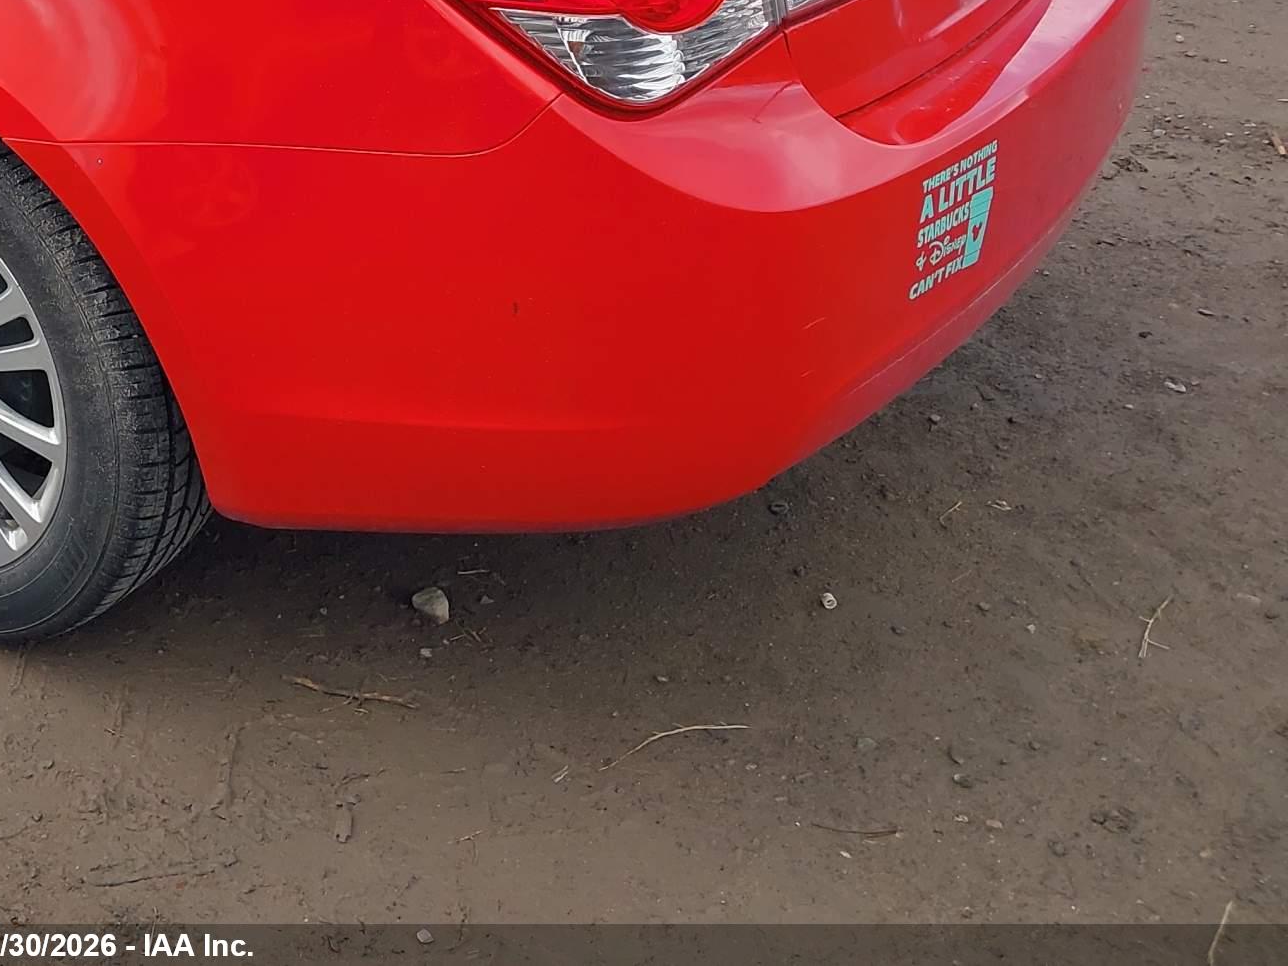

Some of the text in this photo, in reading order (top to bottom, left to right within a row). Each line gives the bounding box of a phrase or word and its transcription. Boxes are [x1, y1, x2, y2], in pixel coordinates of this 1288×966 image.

[919, 155, 997, 224] A LITTLE
[922, 139, 998, 194] THERE'S NOTHING
[917, 201, 971, 249] STARBUCKS
[908, 254, 965, 300] CAN'T FIX
